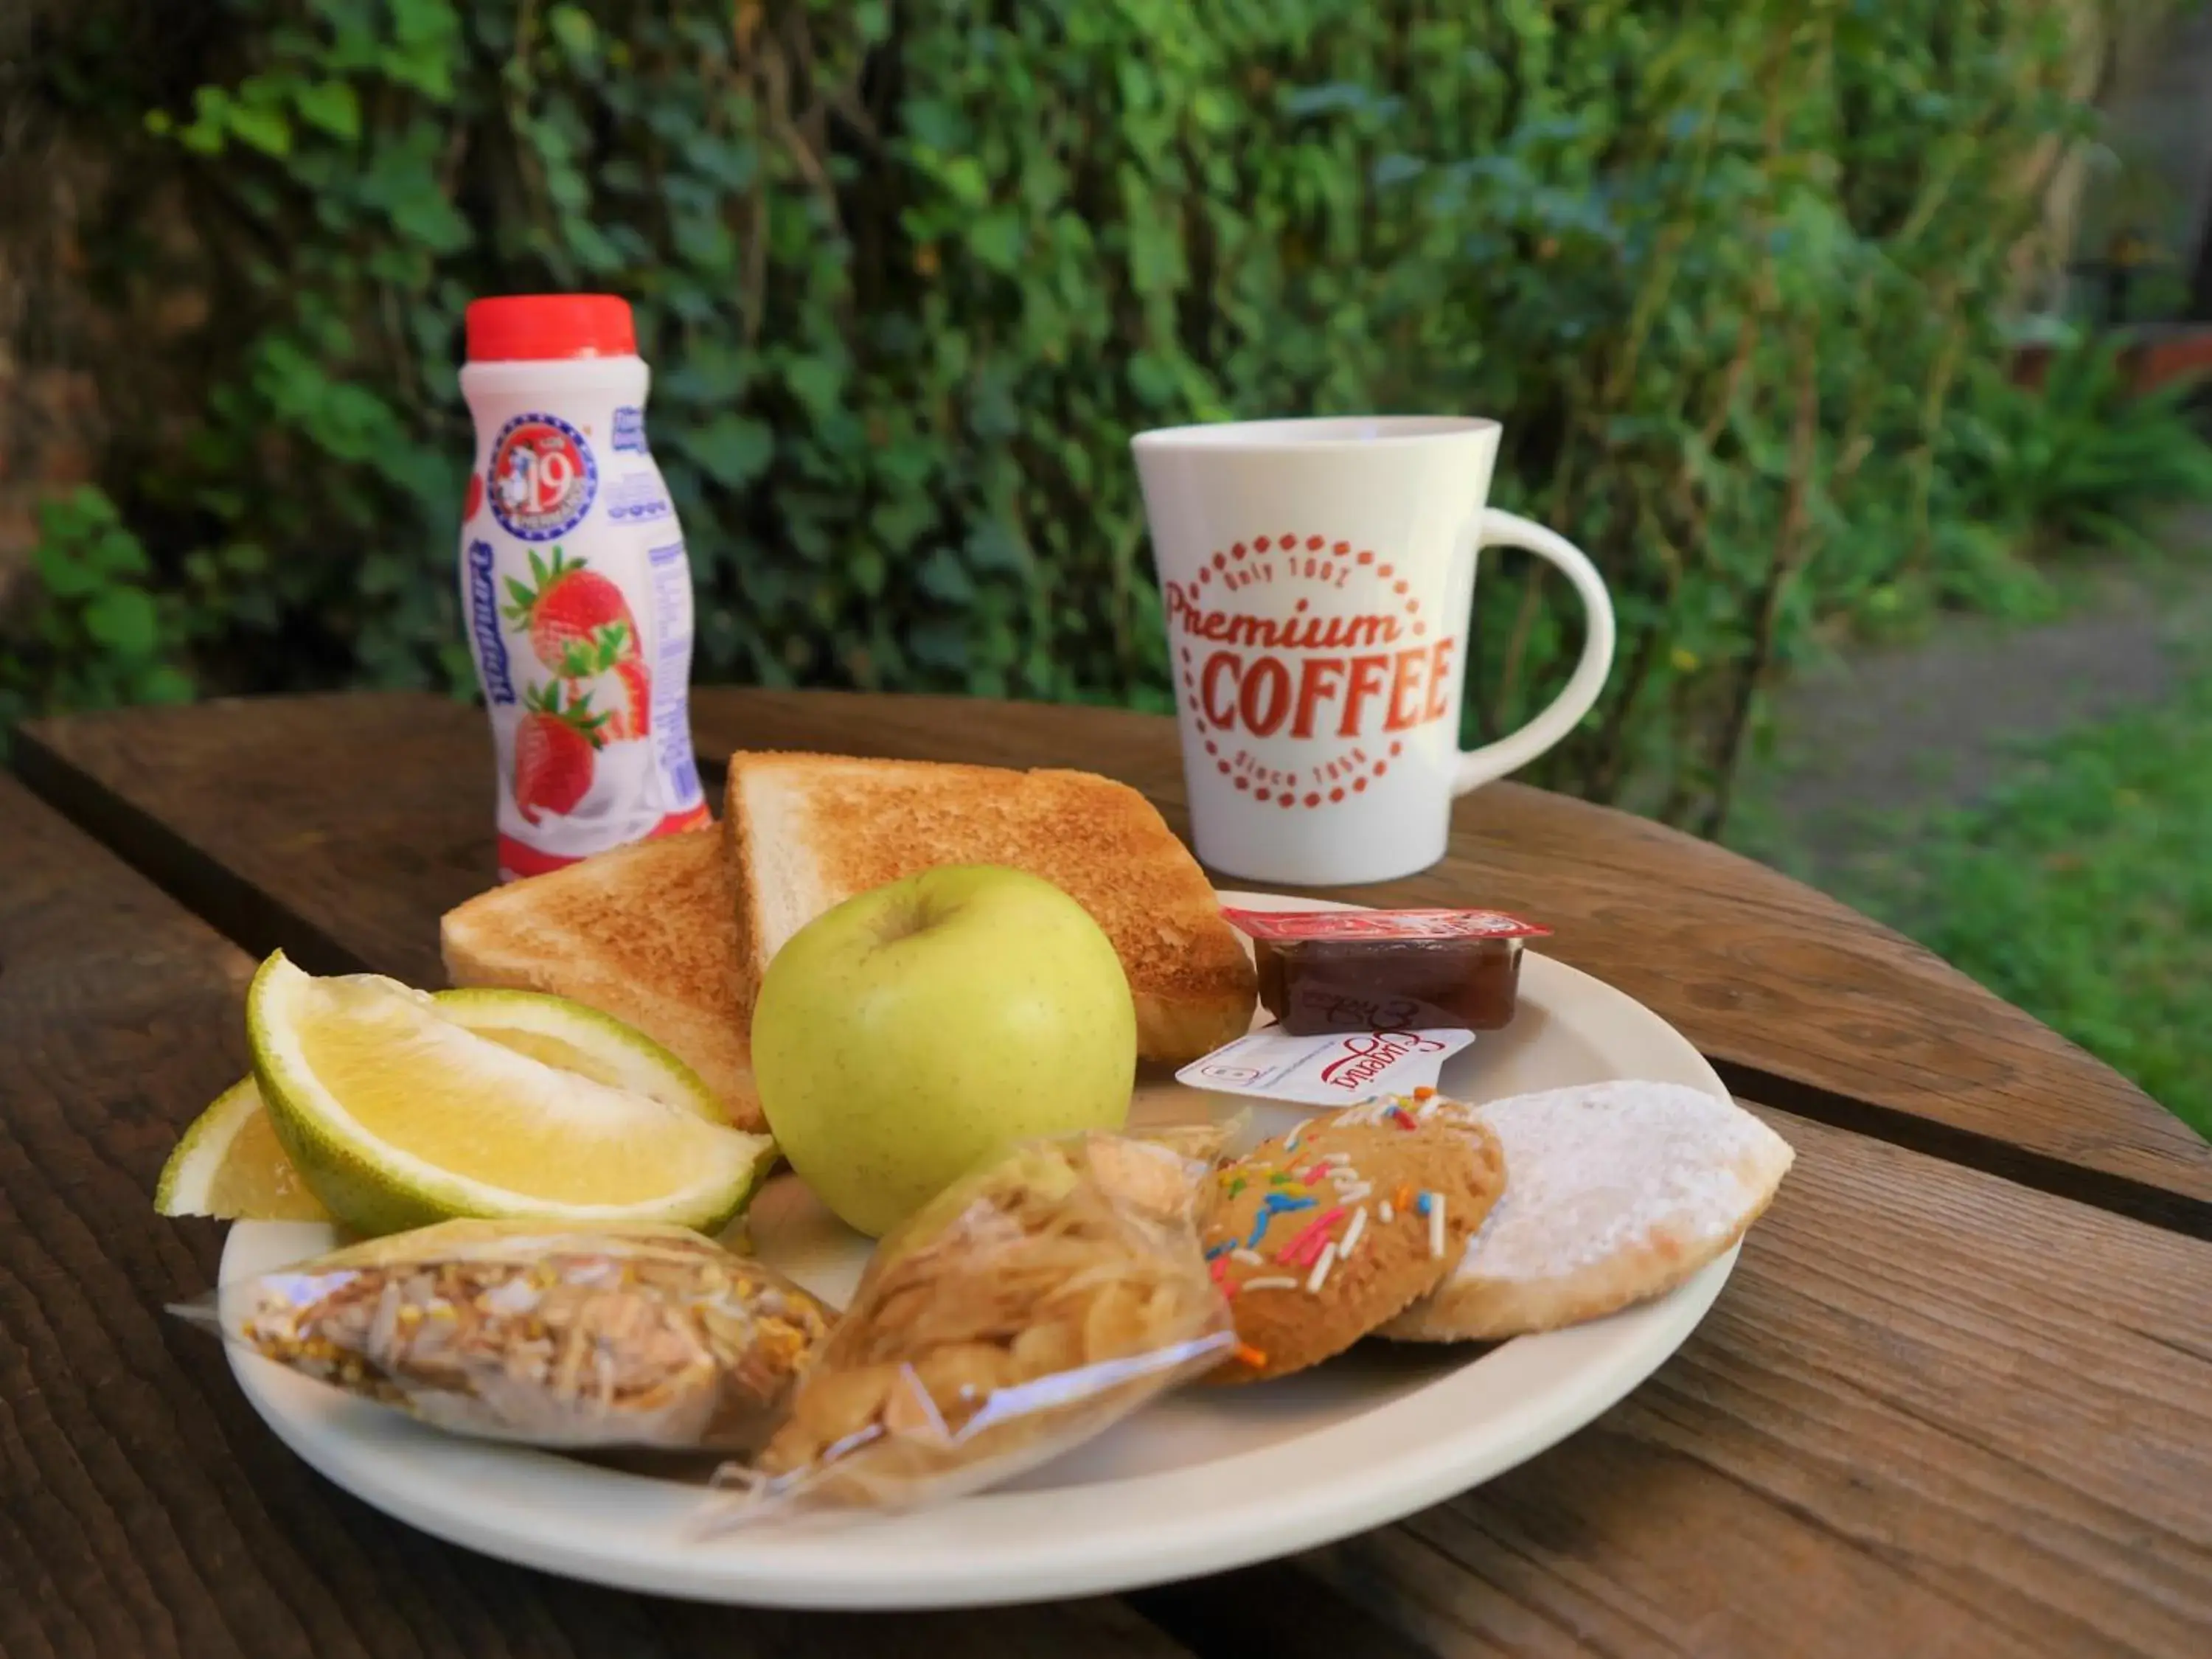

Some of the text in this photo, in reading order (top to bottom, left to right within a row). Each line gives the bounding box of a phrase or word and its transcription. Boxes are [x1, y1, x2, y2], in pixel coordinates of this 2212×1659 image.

[1223, 562, 1272, 592] Only
[1166, 581, 1402, 649] Premium
[1201, 636, 1455, 739] COFFEE
